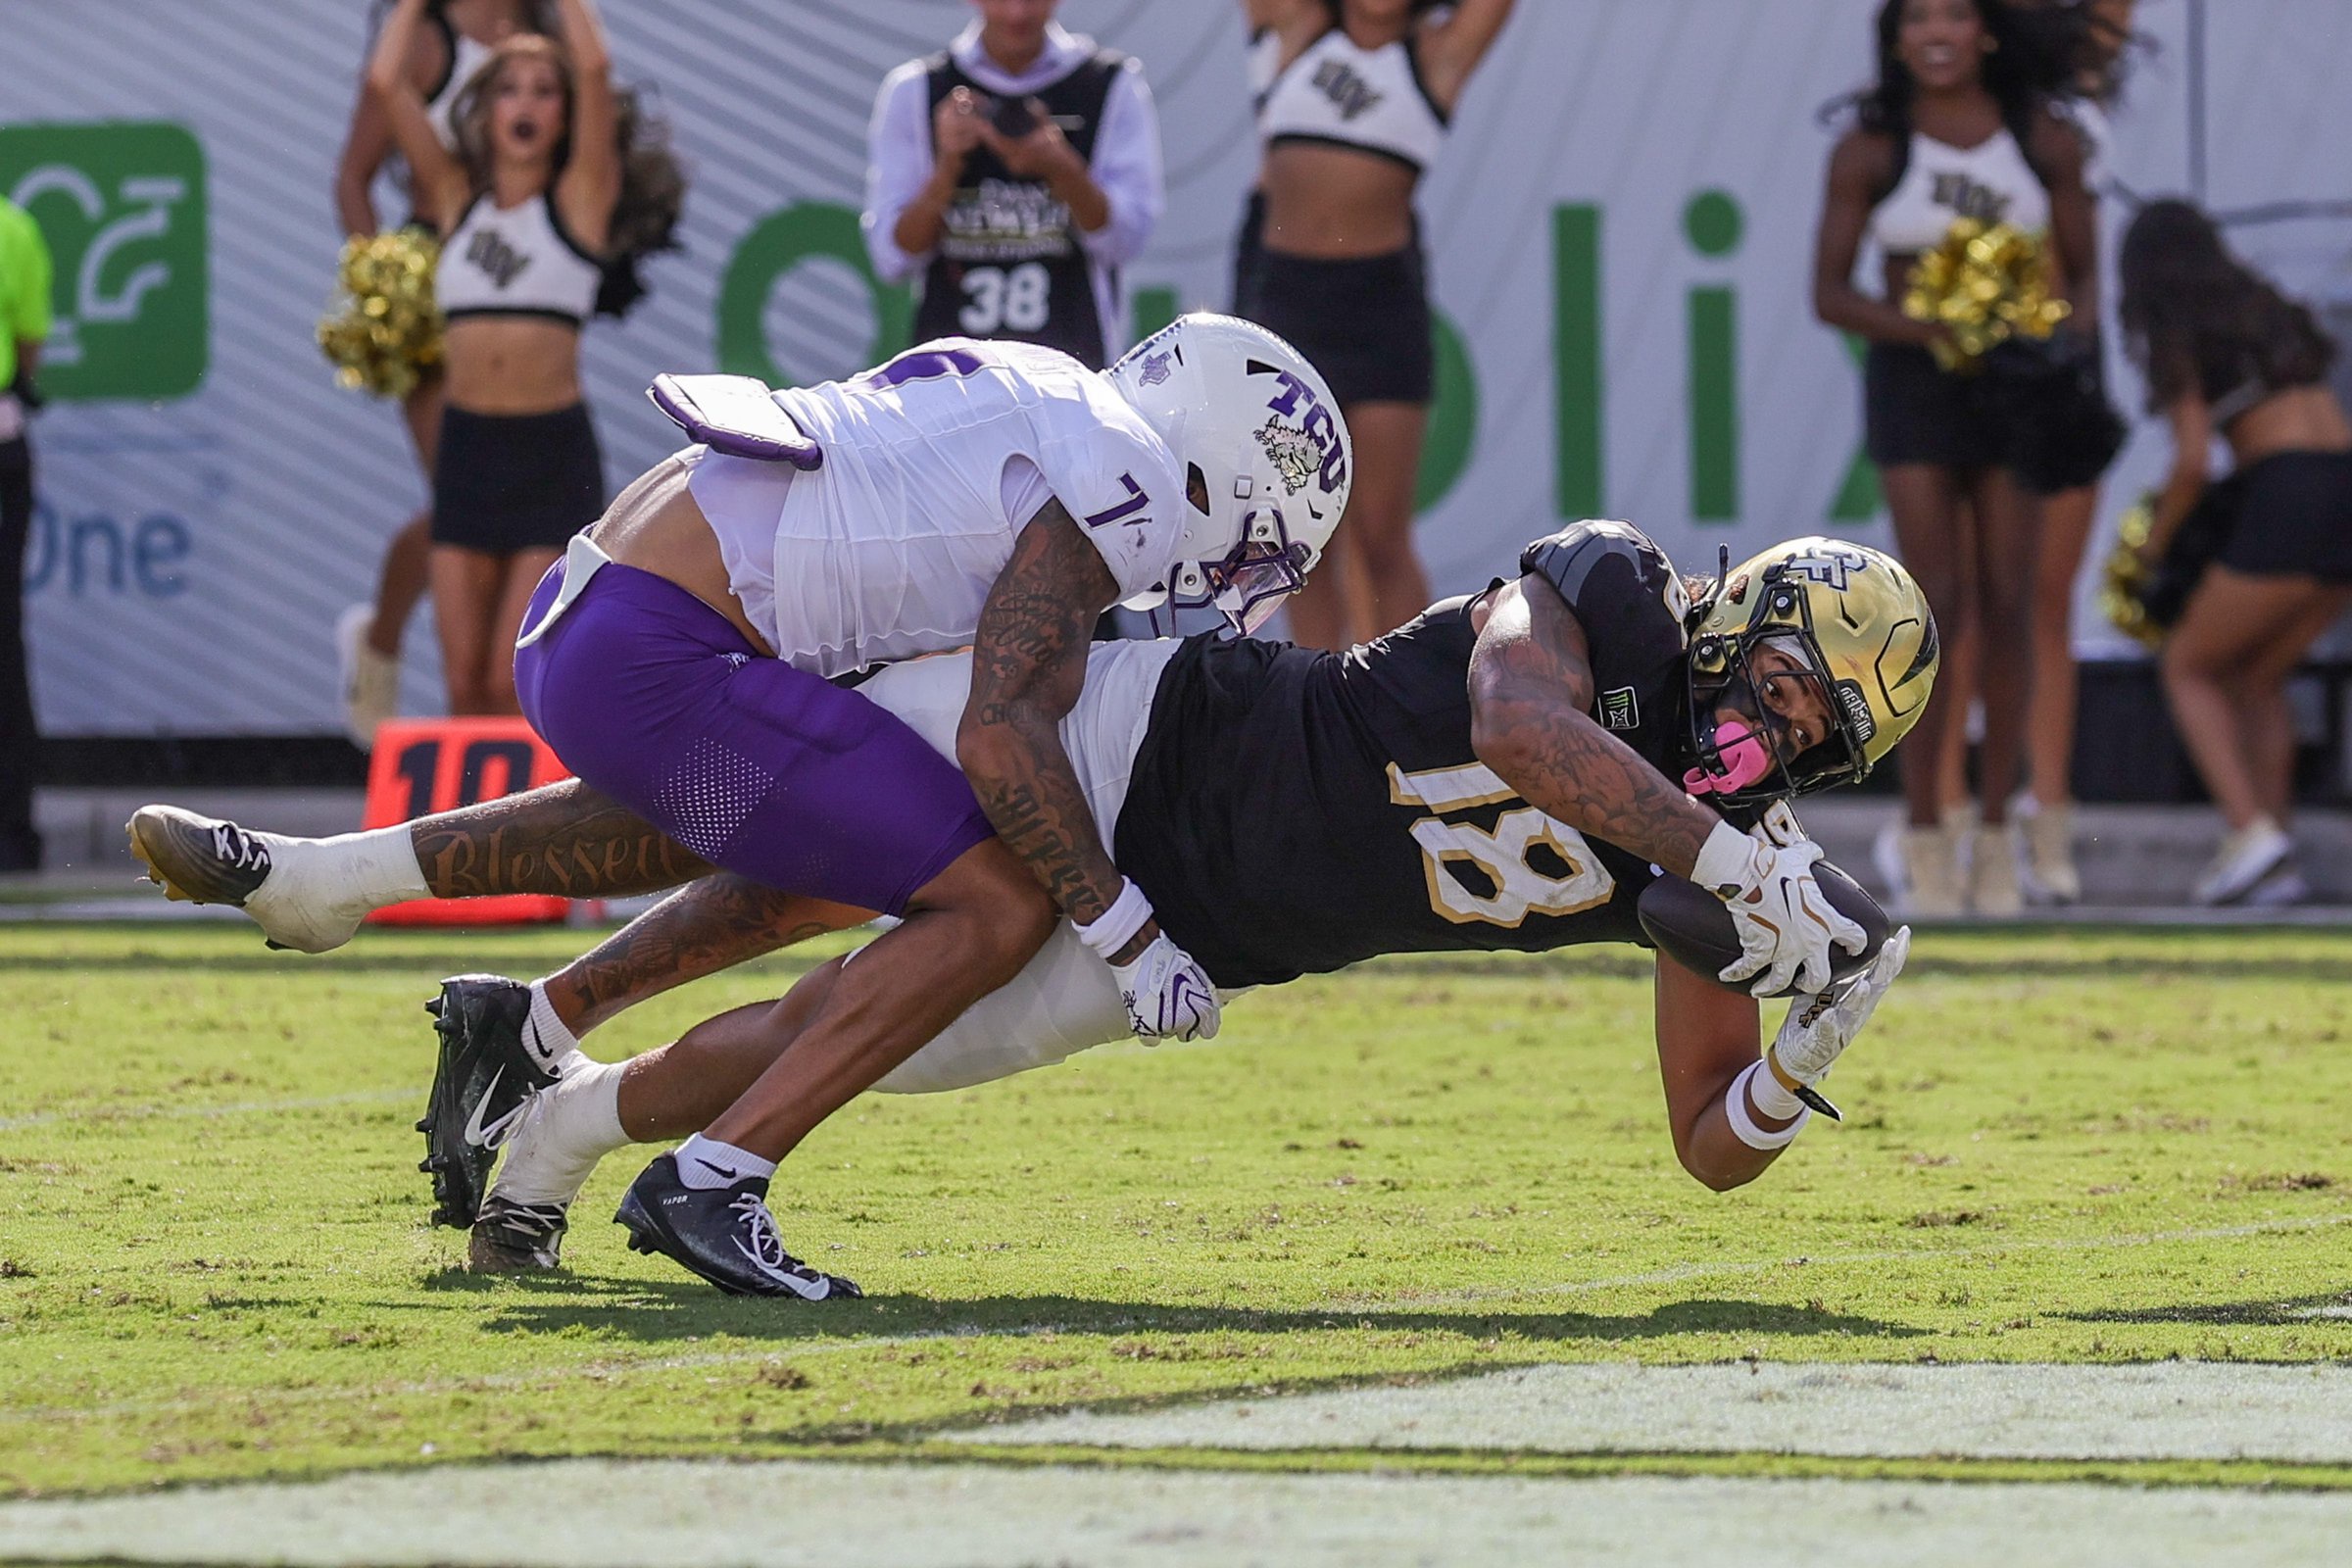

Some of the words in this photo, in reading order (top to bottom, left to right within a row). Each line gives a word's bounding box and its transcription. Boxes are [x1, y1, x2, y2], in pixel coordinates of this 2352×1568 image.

[957, 257, 1051, 335] 38
[1267, 369, 1347, 494] TCU
[1080, 470, 1152, 530] 7
[397, 739, 533, 821] 10
